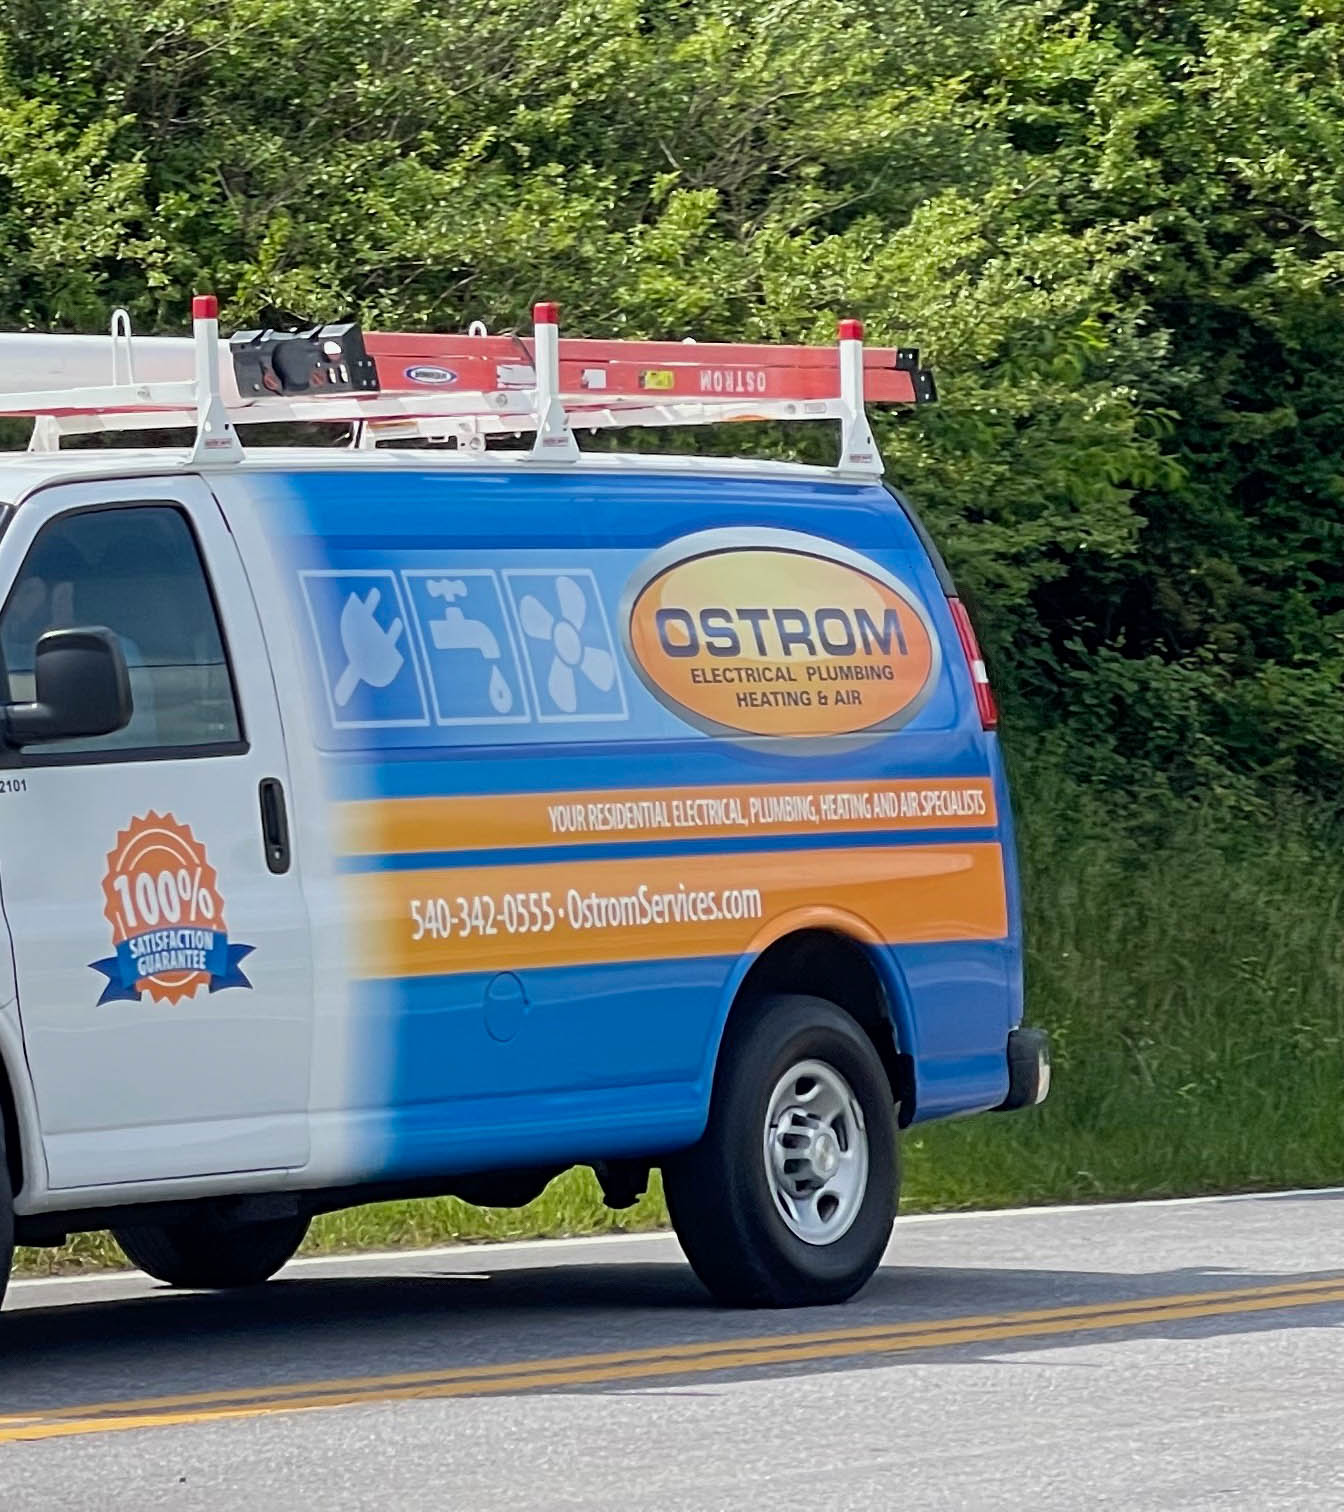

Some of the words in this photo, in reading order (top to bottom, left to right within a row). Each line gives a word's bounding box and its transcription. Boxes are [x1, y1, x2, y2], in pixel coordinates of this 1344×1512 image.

[700, 369, 766, 393] OSTROM
[655, 608, 908, 658] OSTROM
[690, 667, 797, 684] ELECTRICAL
[806, 665, 894, 682] PLUMBING
[736, 691, 811, 708] HEATING
[818, 691, 828, 706] &
[834, 690, 862, 706] AIR
[548, 804, 587, 833] YOUR
[588, 800, 671, 830] RESIDENTIAL
[672, 798, 749, 827] ELECTRICAL,
[749, 795, 819, 824] PLUMBING,
[820, 792, 871, 820] HEATING
[873, 791, 899, 818] AND
[900, 791, 921, 817] AIR
[920, 789, 986, 816] SPECIALISTS
[114, 866, 214, 928] 100%
[410, 891, 555, 940] 540-342-0555
[567, 883, 762, 929] OstromServices.com
[128, 930, 214, 959] SATISFACTION
[137, 950, 207, 976] GUARANTEE
